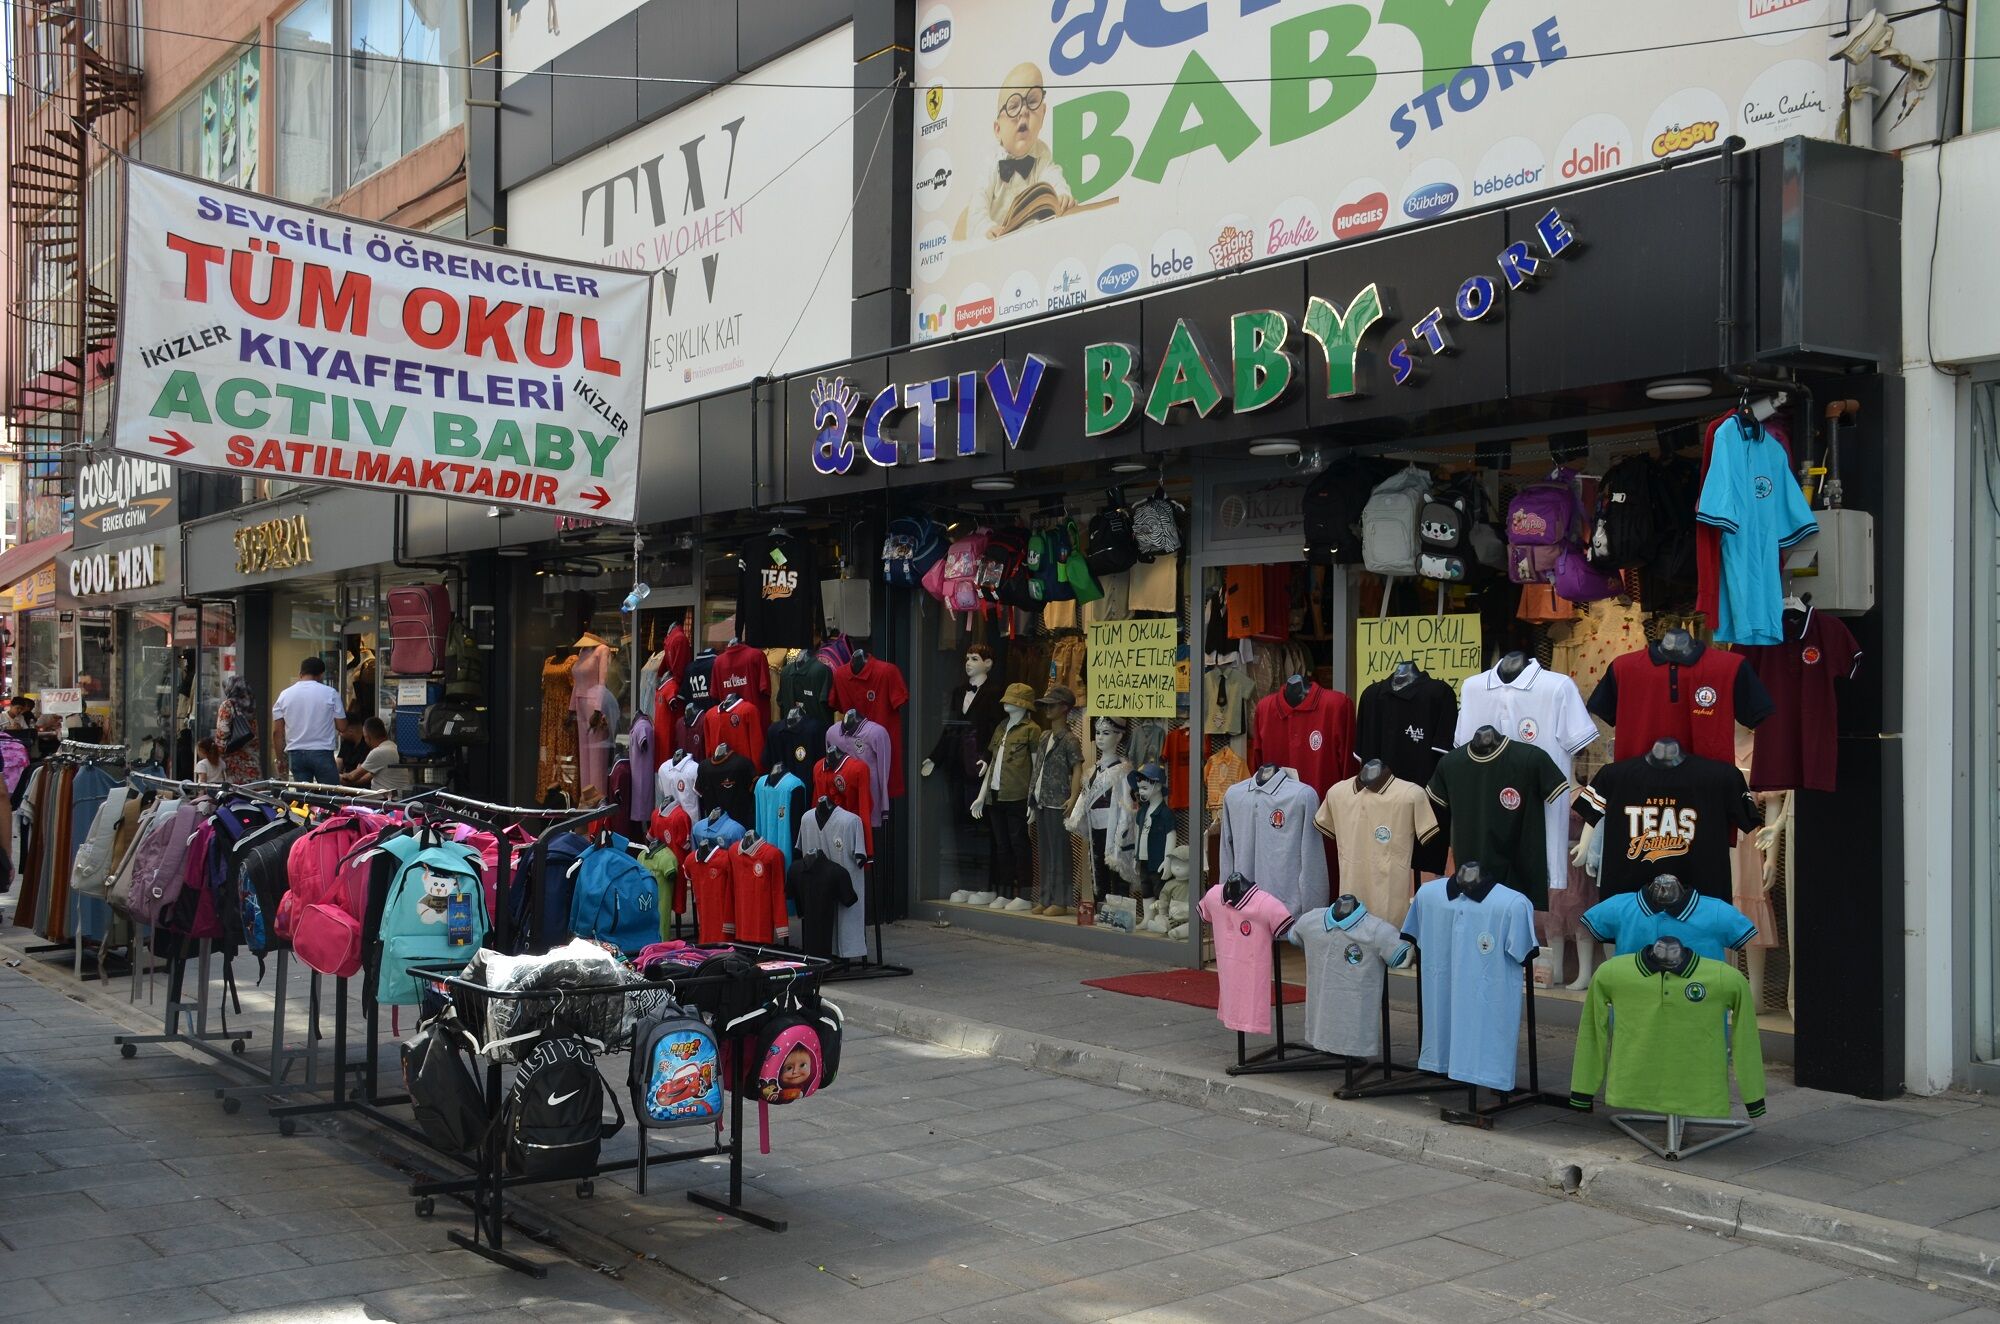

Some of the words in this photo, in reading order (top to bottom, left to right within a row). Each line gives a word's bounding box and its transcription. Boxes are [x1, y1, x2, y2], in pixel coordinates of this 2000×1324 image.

[921, 27, 950, 50] chicco
[1389, 15, 1568, 151] STORE
[1053, 0, 1491, 203] BABY
[1744, 103, 1775, 124] Pierre
[921, 117, 948, 136] Ferrari
[1652, 121, 1720, 158] COSBY
[1561, 142, 1621, 179] dalin
[1407, 191, 1454, 212] Bübchen
[654, 203, 743, 264] WOMEN
[1337, 208, 1383, 231] HUGGIES
[197, 196, 353, 255] SEVGİLİ
[366, 234, 600, 298] ÖĞRENCİLER
[920, 236, 947, 251] PHILIPS
[1209, 230, 1253, 264] Bright
[1267, 216, 1319, 255] Barbie
[921, 252, 944, 266] AVENT
[1151, 248, 1193, 278] bebe
[1215, 247, 1253, 270] Starts
[1100, 268, 1137, 290] playgro
[166, 231, 372, 338] TÜM
[402, 287, 621, 377] OKUL
[956, 304, 993, 322] fisher-price
[999, 297, 1038, 315] Lansinoh
[1047, 288, 1087, 312] PENATEN
[1084, 283, 1384, 438] BABY
[1388, 207, 1574, 386] STORE
[139, 325, 232, 368] İKİZLER
[666, 322, 710, 372] ŞIKLIK
[716, 313, 743, 351] KAT
[239, 328, 564, 411] KIYAFETLERİ
[572, 376, 629, 437] İKİZLER
[149, 369, 408, 448] ACTIV
[433, 411, 621, 478] BABY
[79, 457, 118, 510] COOL
[131, 457, 171, 498] MEN
[225, 435, 560, 505] SATILMAKTADIR
[102, 512, 124, 533] ERKEK
[124, 506, 147, 529] GİYİM
[70, 553, 115, 597] COOL
[118, 544, 155, 590] MEN
[760, 568, 798, 589] TEAS
[1090, 623, 1122, 646] TÜM
[1128, 622, 1171, 643] OKUL
[1360, 618, 1410, 645] TÜM
[1416, 616, 1475, 644] OKUL
[1092, 646, 1177, 669] KIYAFETLERİ
[1366, 646, 1481, 676] KIYAFETLERİ
[689, 674, 708, 692] 112
[1097, 670, 1175, 692] MAĞAZAMIZA
[1624, 805, 1698, 841] TEAS
[670, 1041, 697, 1055] RACE
